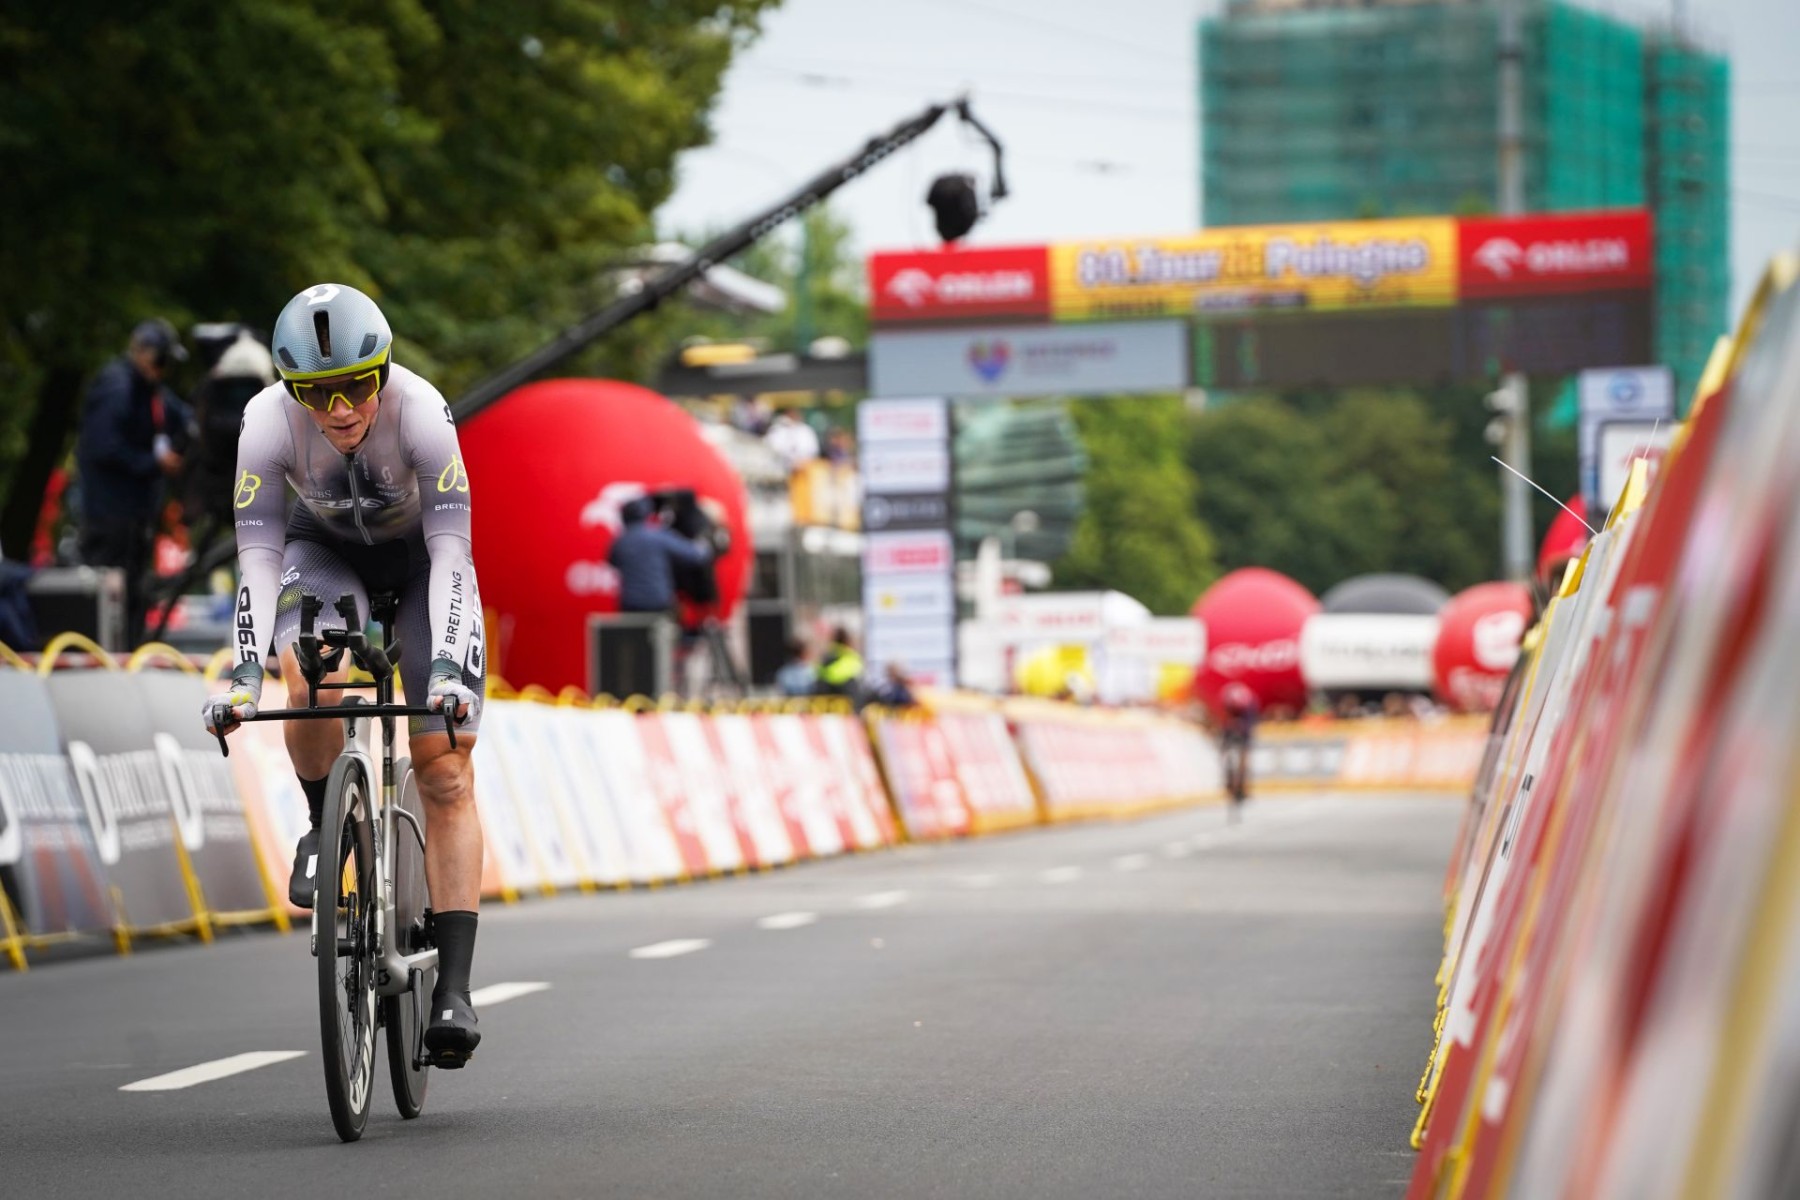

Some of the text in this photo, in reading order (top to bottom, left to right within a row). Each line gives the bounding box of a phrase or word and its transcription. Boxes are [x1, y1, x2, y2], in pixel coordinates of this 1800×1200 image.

[434, 503, 471, 511] BREITL
[237, 586, 259, 663] Q36.5
[444, 571, 462, 645] BREITLING
